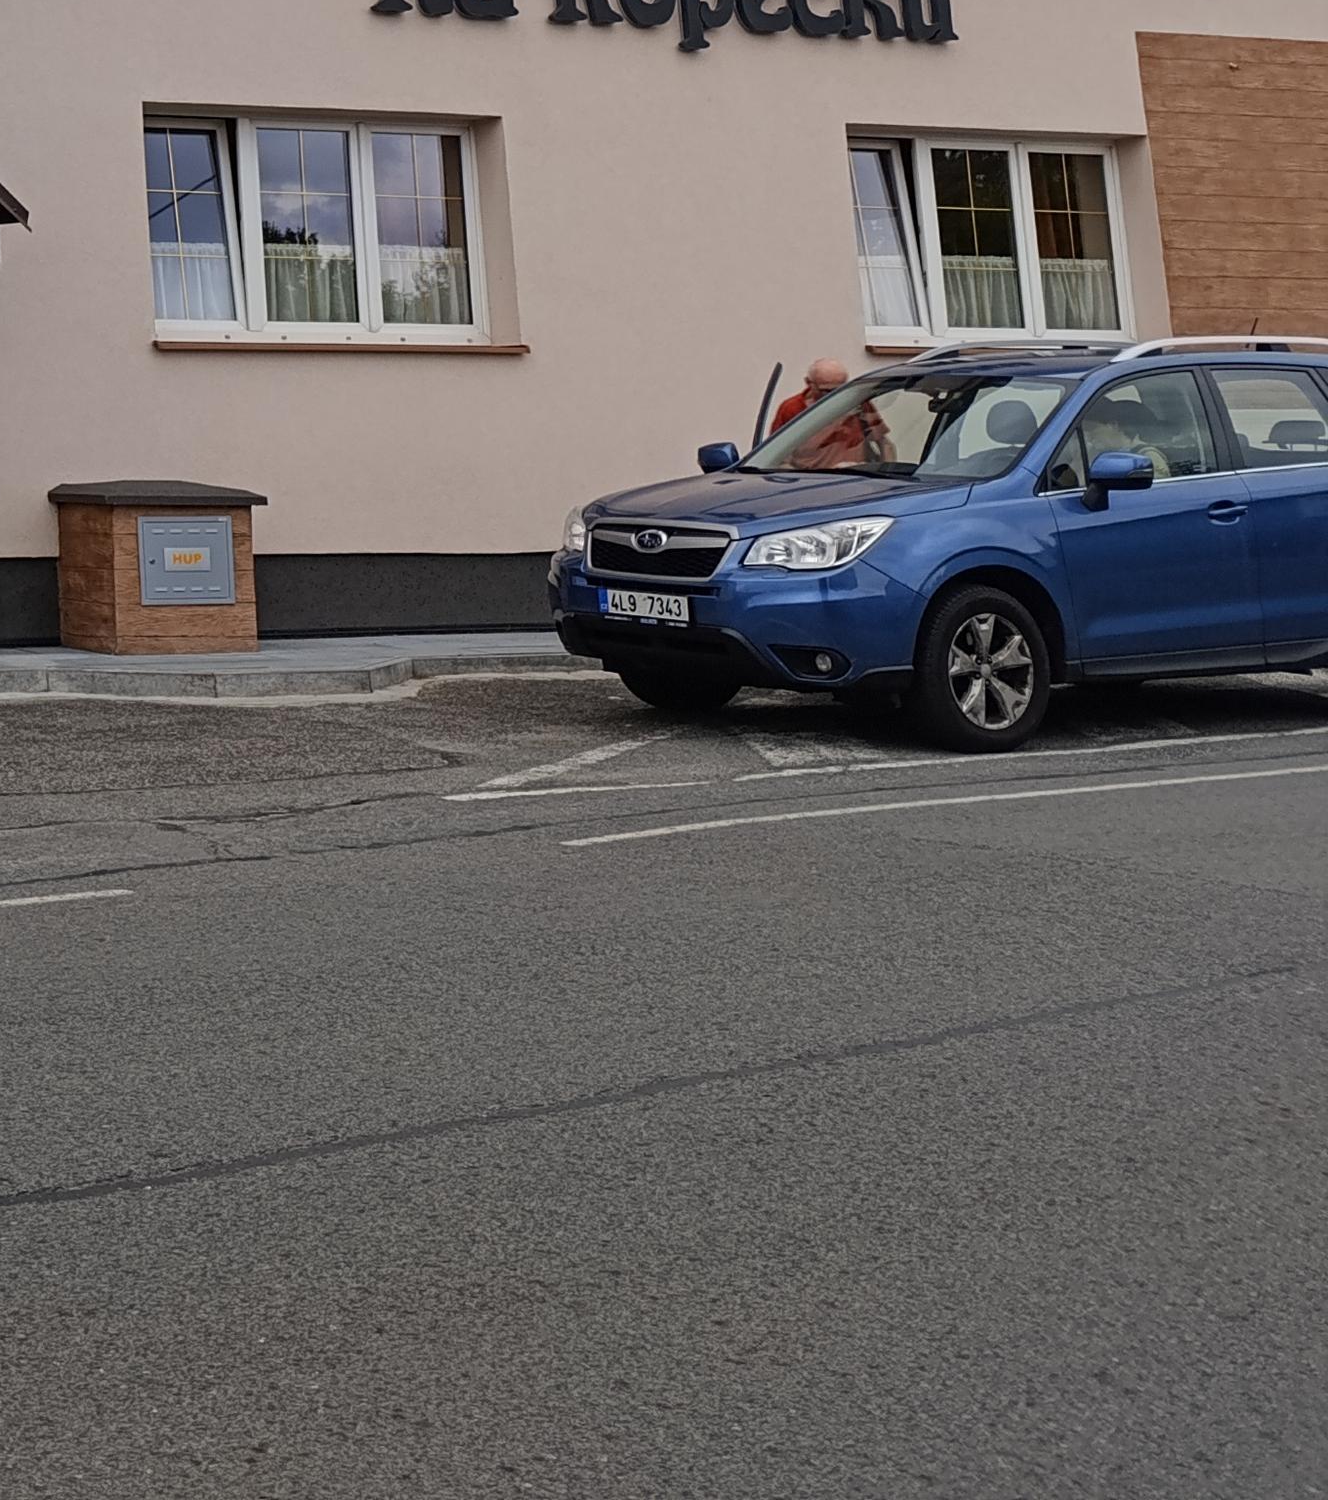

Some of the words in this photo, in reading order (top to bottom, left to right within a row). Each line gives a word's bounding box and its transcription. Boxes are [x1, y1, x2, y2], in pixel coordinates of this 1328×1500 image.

[172, 553, 202, 565] HUP
[611, 593, 637, 612] 4L9
[647, 596, 682, 617] 7343
